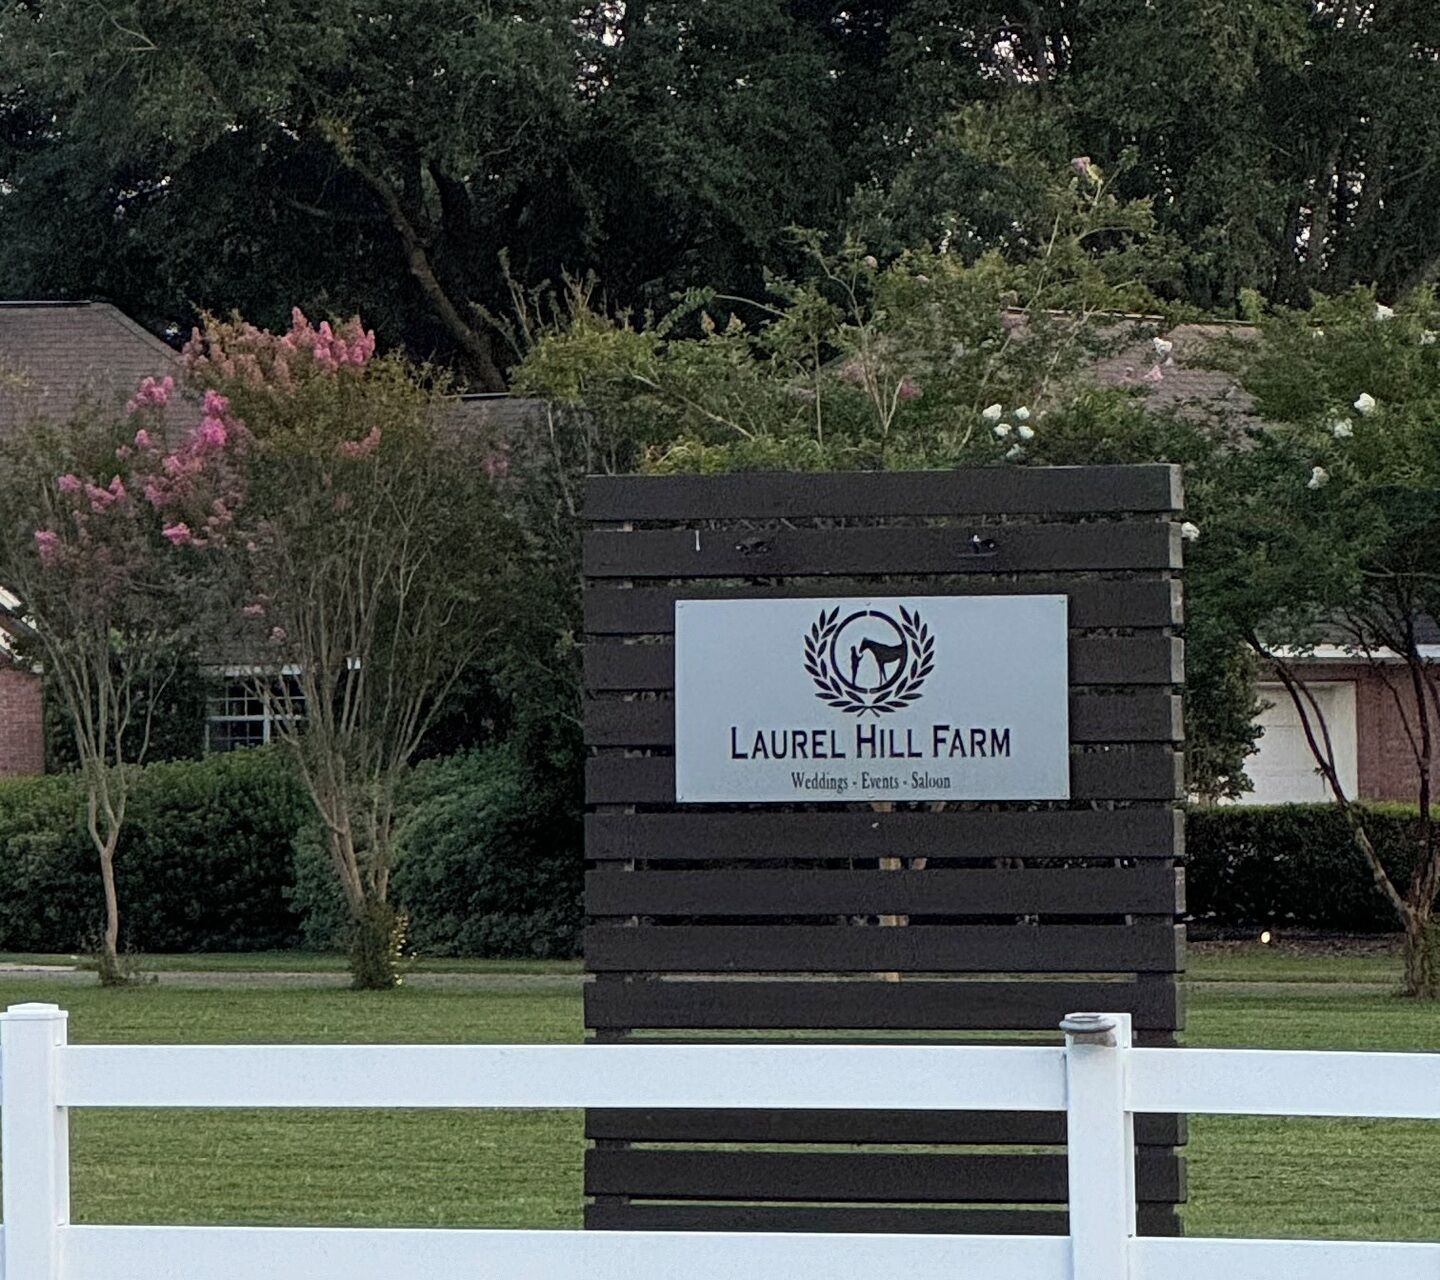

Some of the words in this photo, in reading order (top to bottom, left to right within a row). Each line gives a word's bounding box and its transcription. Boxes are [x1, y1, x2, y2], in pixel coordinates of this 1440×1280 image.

[730, 726, 847, 760] LAUREL
[855, 723, 923, 759] HILL
[932, 724, 1011, 759] FARM
[790, 771, 849, 794] Weddings
[861, 771, 900, 790] Events
[910, 770, 951, 790] Saloon
